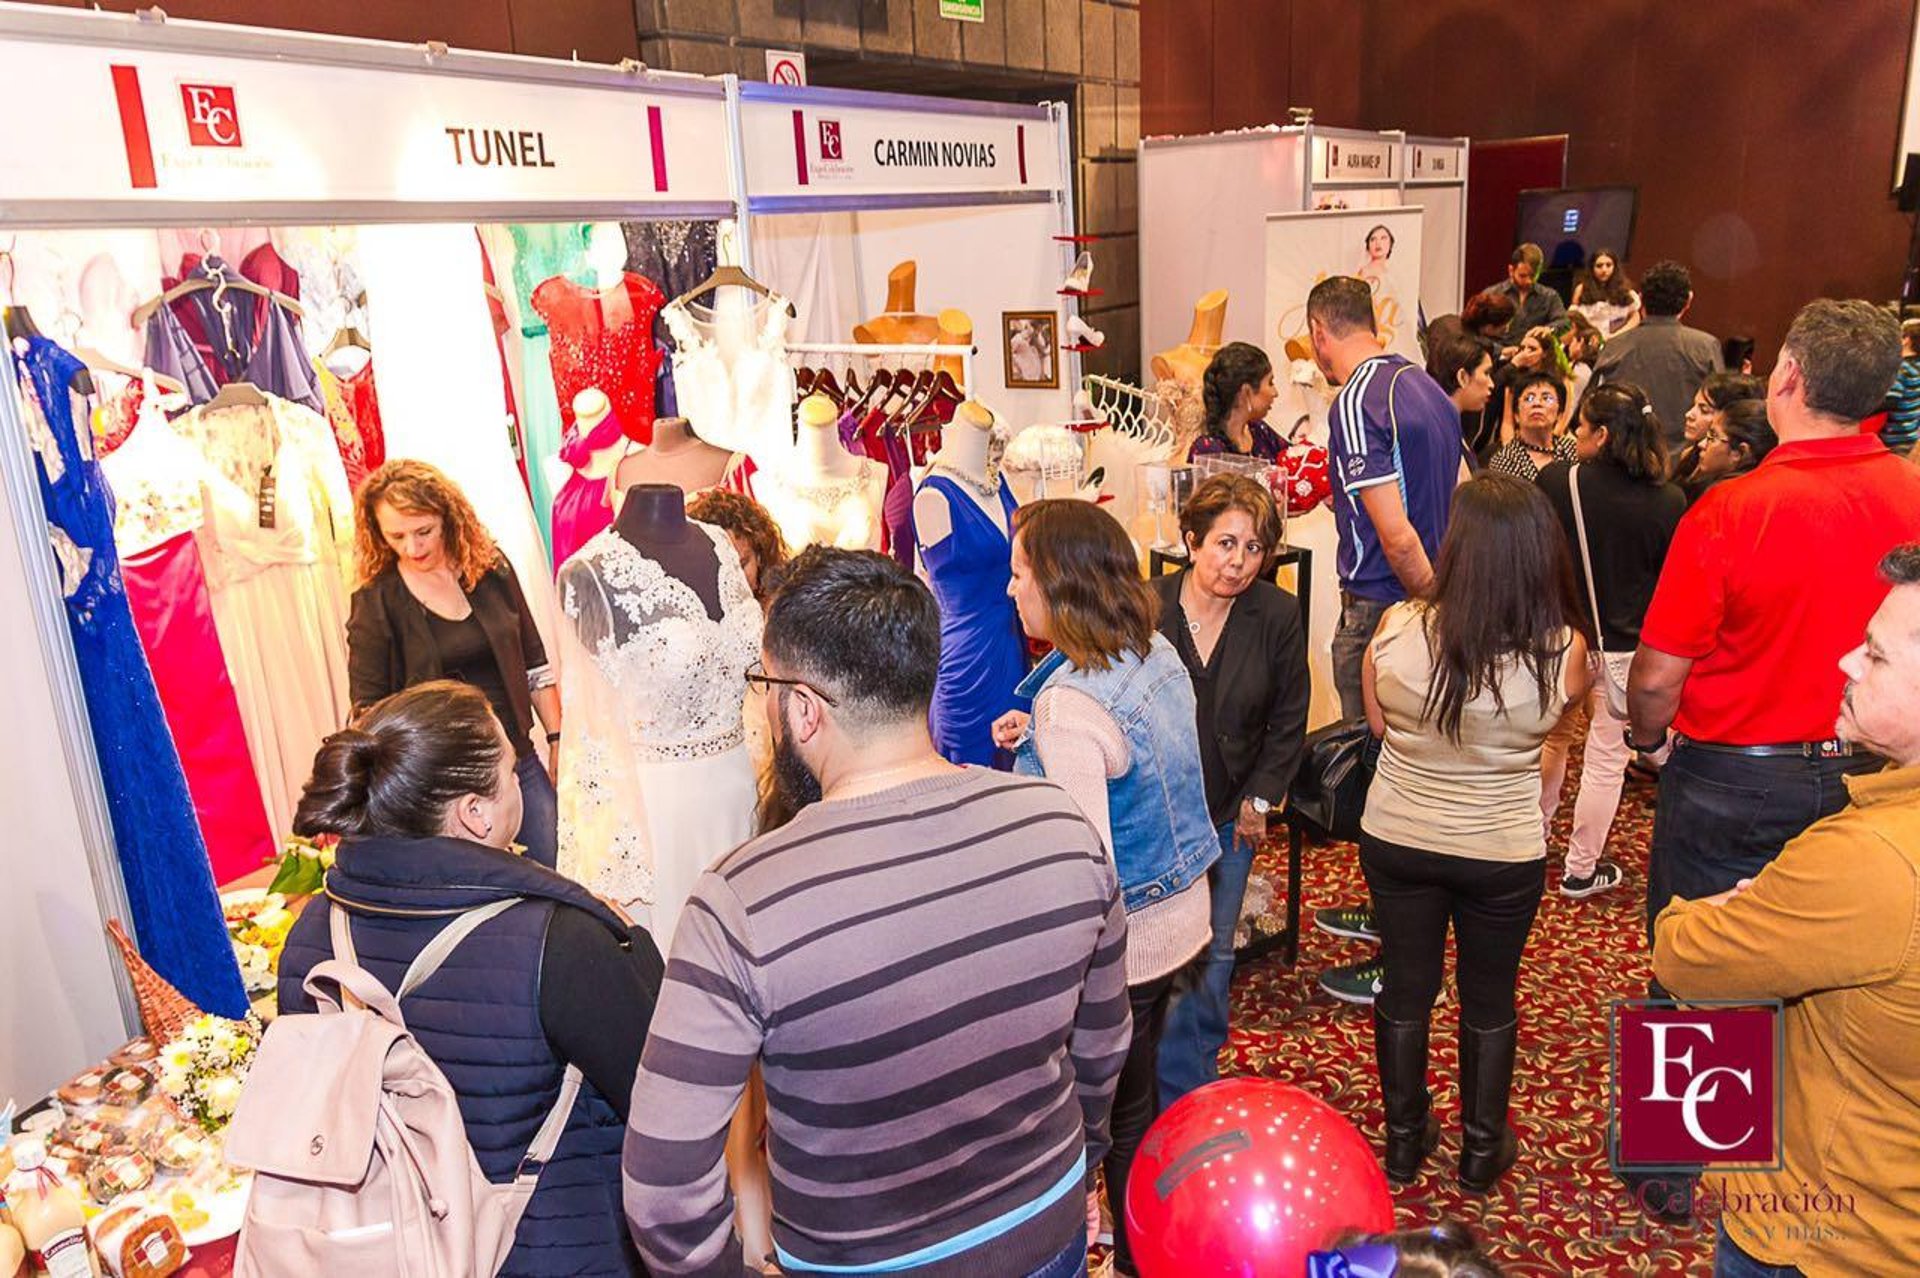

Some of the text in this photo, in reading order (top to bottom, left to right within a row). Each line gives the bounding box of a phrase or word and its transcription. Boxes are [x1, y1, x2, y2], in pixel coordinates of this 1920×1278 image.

[188, 87, 237, 145] EC
[445, 127, 556, 168] TUNEL
[821, 122, 841, 158] EC
[874, 138, 996, 168] CARMIN NOVIAS
